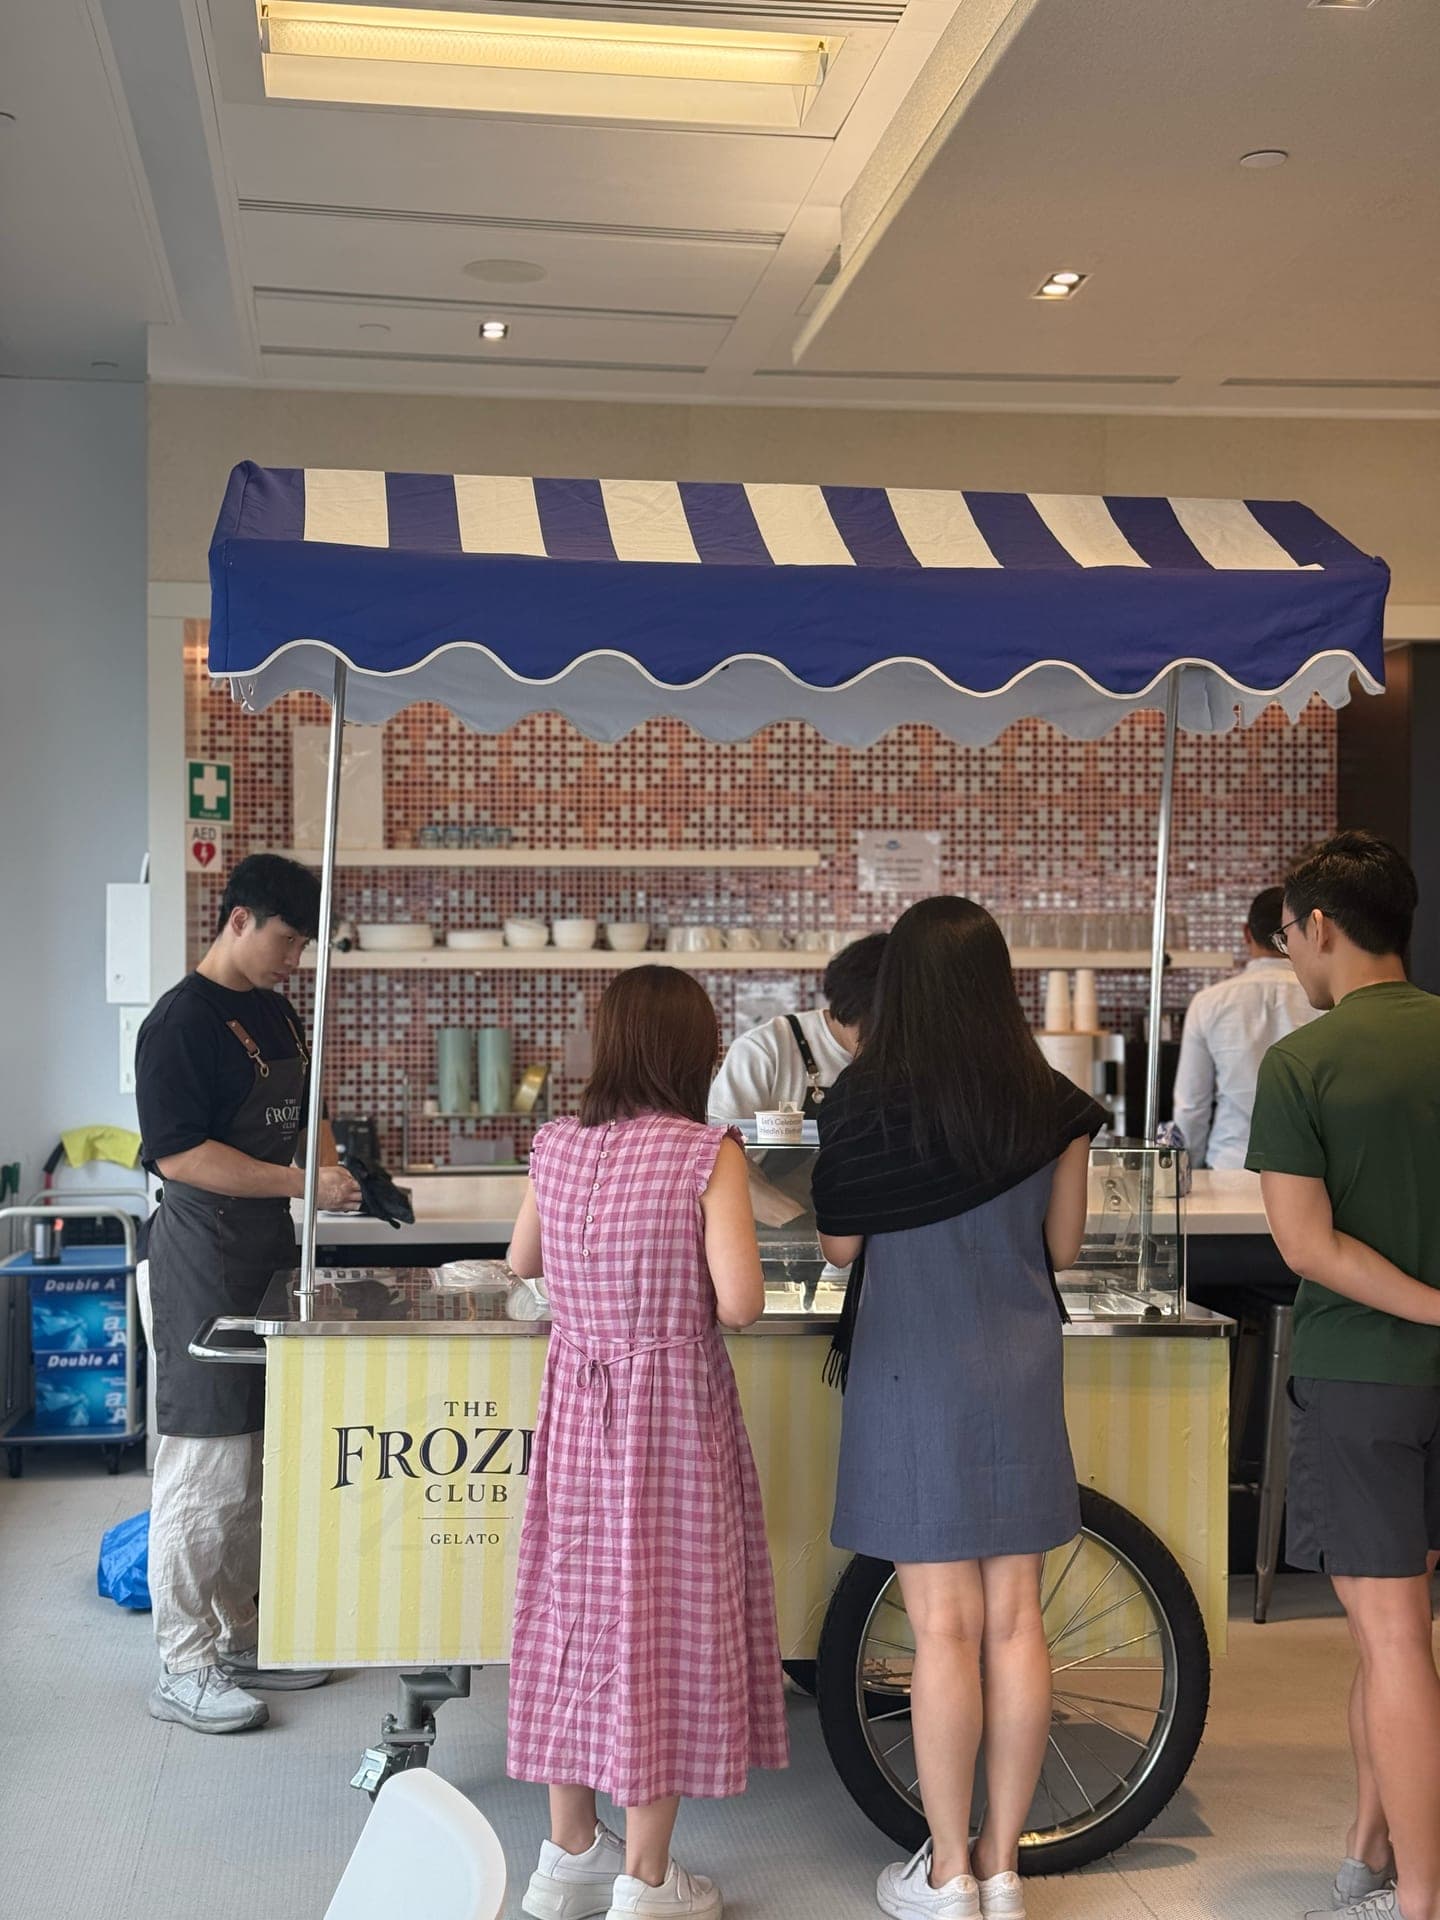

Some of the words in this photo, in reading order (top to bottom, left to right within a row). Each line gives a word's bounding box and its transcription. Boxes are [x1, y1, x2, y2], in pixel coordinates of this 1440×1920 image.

[193, 827, 216, 841] AED
[44, 1278, 101, 1292] Double
[104, 1278, 116, 1291] A
[47, 1353, 103, 1368] Double
[107, 1353, 119, 1366] A
[444, 1400, 498, 1417] THE
[424, 1484, 508, 1503] CLUB
[430, 1533, 500, 1545] GELATO
